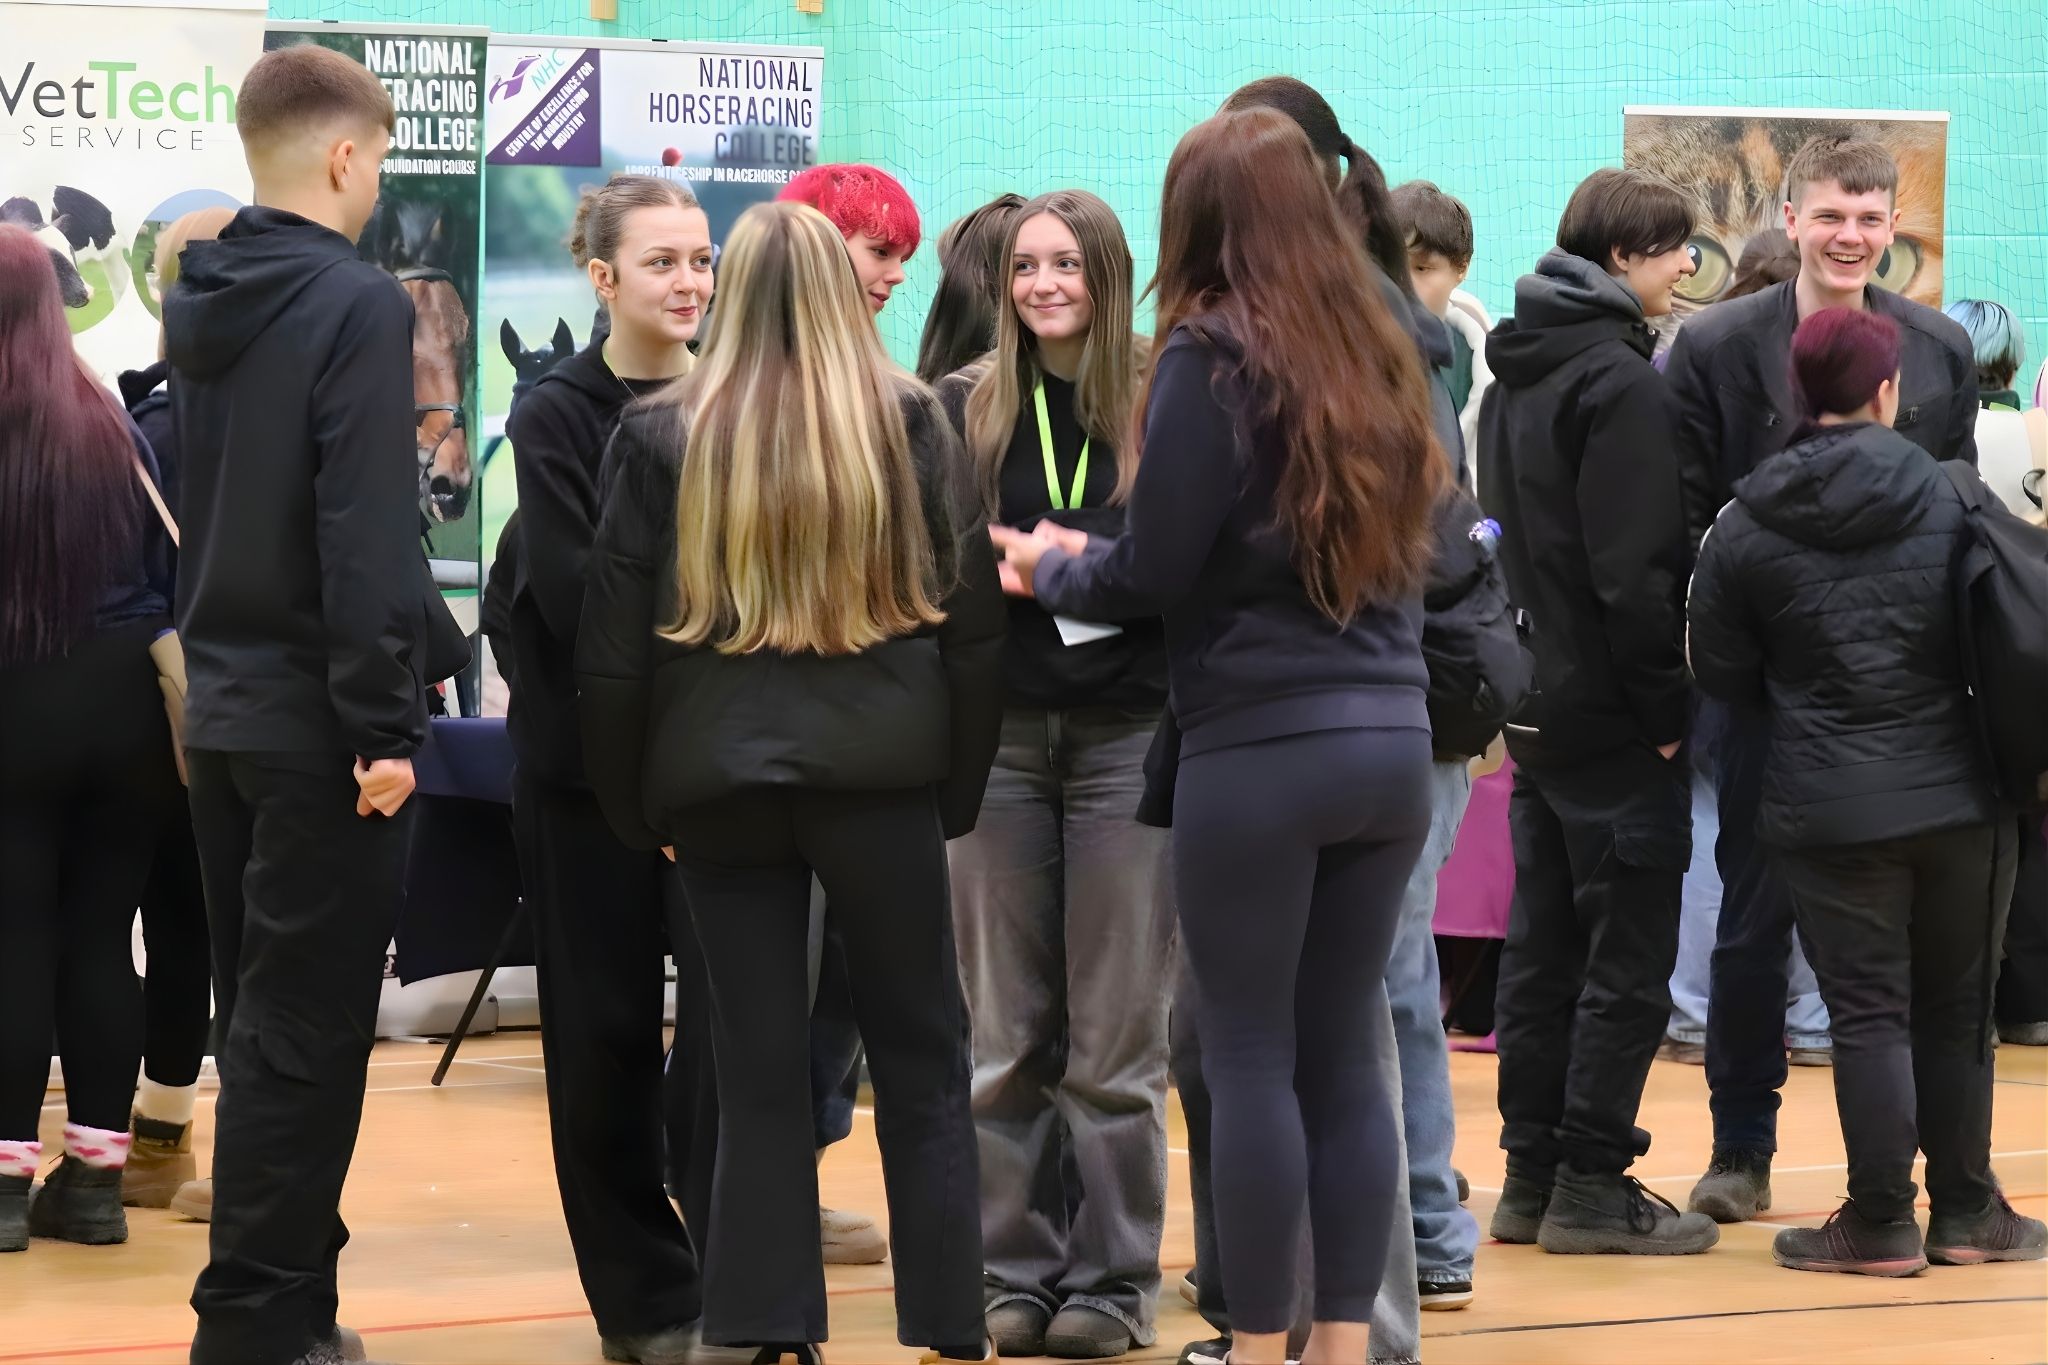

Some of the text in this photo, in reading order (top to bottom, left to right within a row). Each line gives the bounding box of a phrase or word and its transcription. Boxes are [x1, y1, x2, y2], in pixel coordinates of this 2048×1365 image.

[365, 39, 476, 75] NATIONAL
[530, 47, 565, 91] NHC
[699, 57, 813, 92] NATIONAL
[0, 61, 237, 124] VetTech
[505, 61, 595, 157] CENTRE OF EXCELLENCE FOR
[649, 92, 812, 128] HORSERACING
[387, 116, 477, 151] OLLEGE
[530, 87, 590, 152] THE HORSERACING
[551, 111, 587, 151] INDUSTRY
[22, 125, 203, 151] SERVICE
[442, 159, 477, 175] COURSE
[714, 167, 726, 182] IN
[726, 168, 788, 184] RACEHORSE
